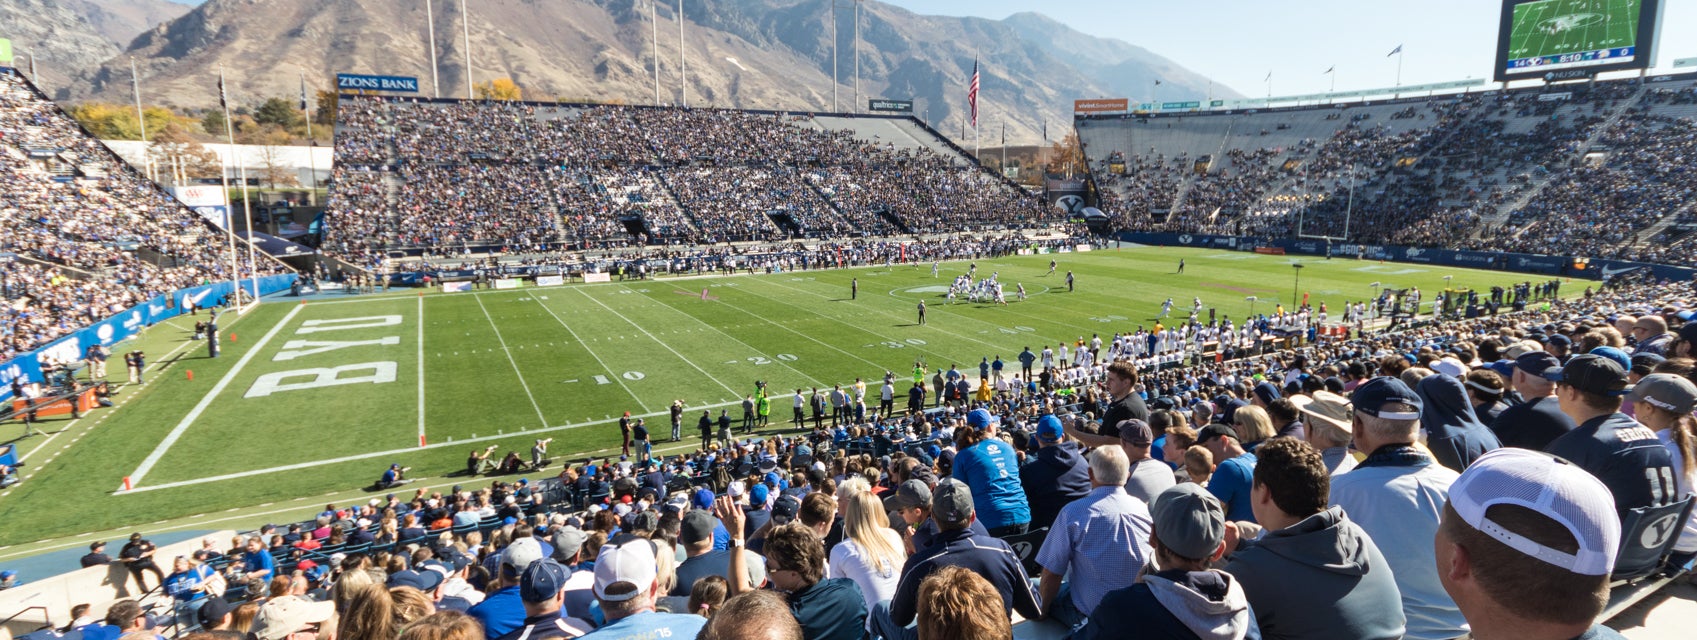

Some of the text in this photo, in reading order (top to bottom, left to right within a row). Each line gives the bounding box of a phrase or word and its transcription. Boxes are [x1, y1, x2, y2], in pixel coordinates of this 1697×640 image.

[1559, 53, 1582, 62] 8:10
[1620, 48, 1629, 56] 0
[339, 76, 417, 90] ZIONS BANK
[243, 315, 402, 398] BYU
[747, 353, 799, 366] 20
[592, 370, 646, 385] 10
[1645, 466, 1675, 507] 11
